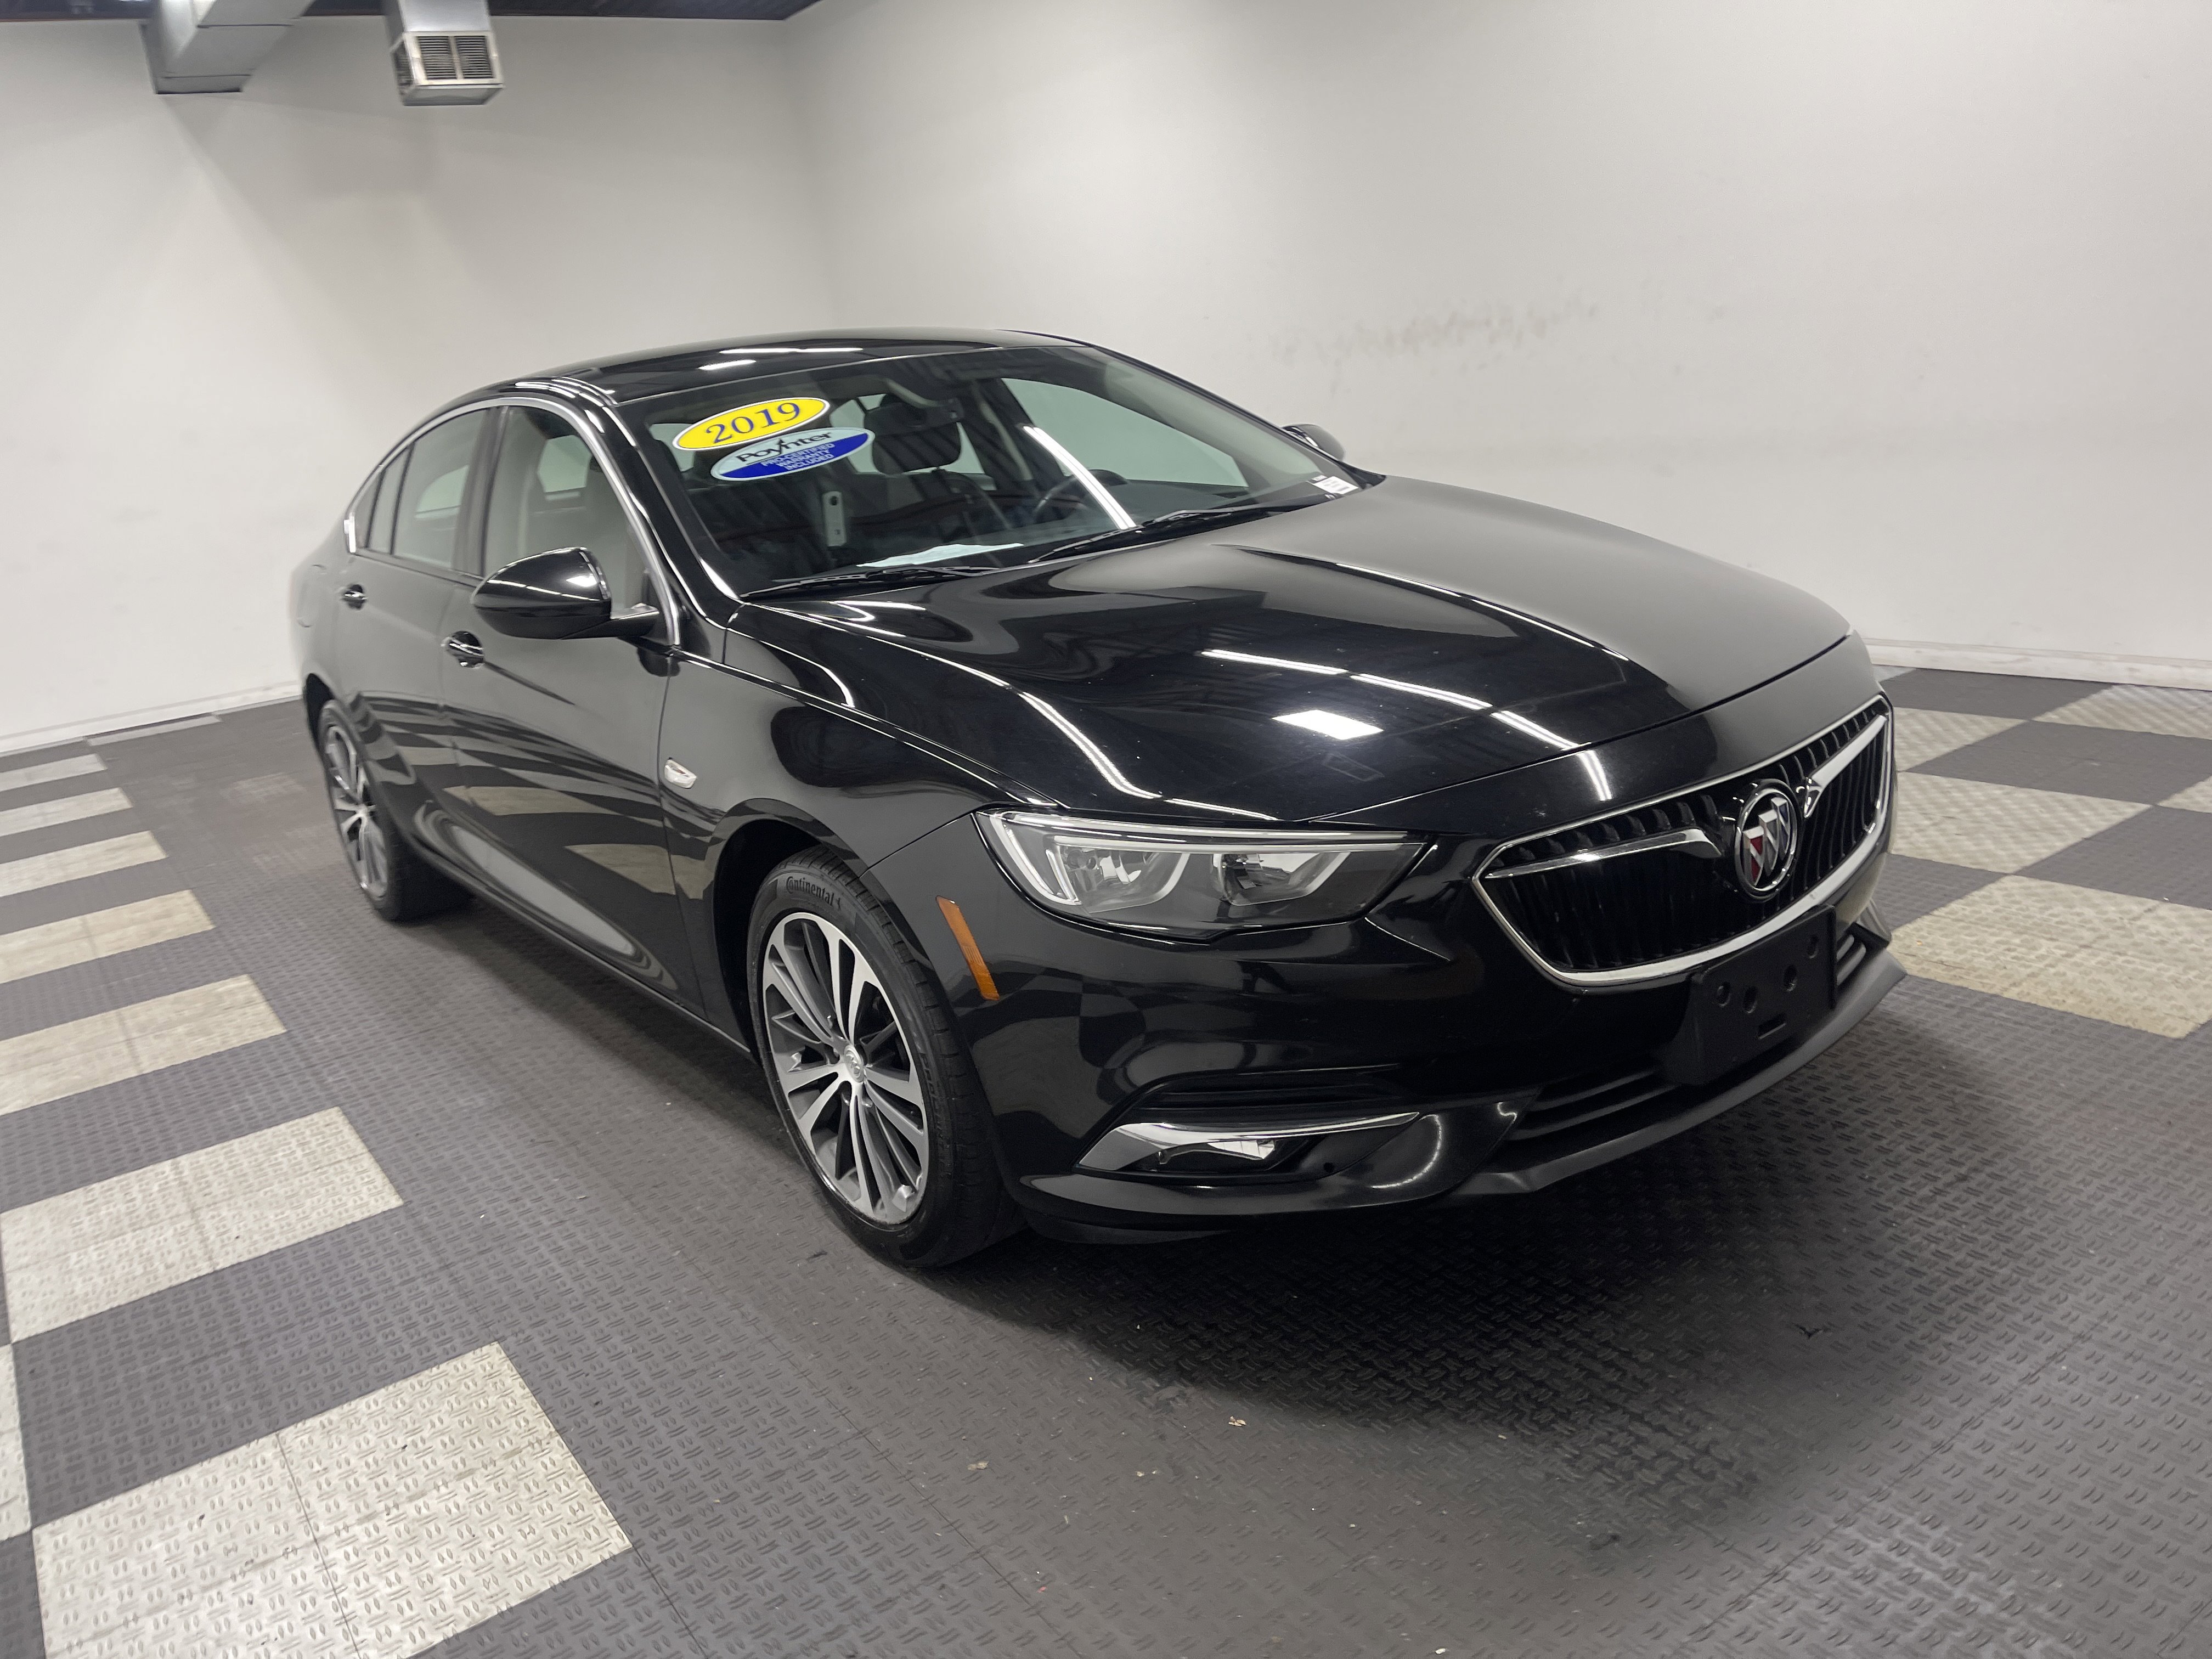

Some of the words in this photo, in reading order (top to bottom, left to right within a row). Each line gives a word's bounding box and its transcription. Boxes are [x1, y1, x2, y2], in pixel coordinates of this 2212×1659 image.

[706, 402, 800, 443] 2019
[736, 432, 831, 462] Poynter
[776, 449, 831, 468] WARRANTY
[785, 454, 834, 470] INCLUDED
[786, 876, 834, 907] Continental
